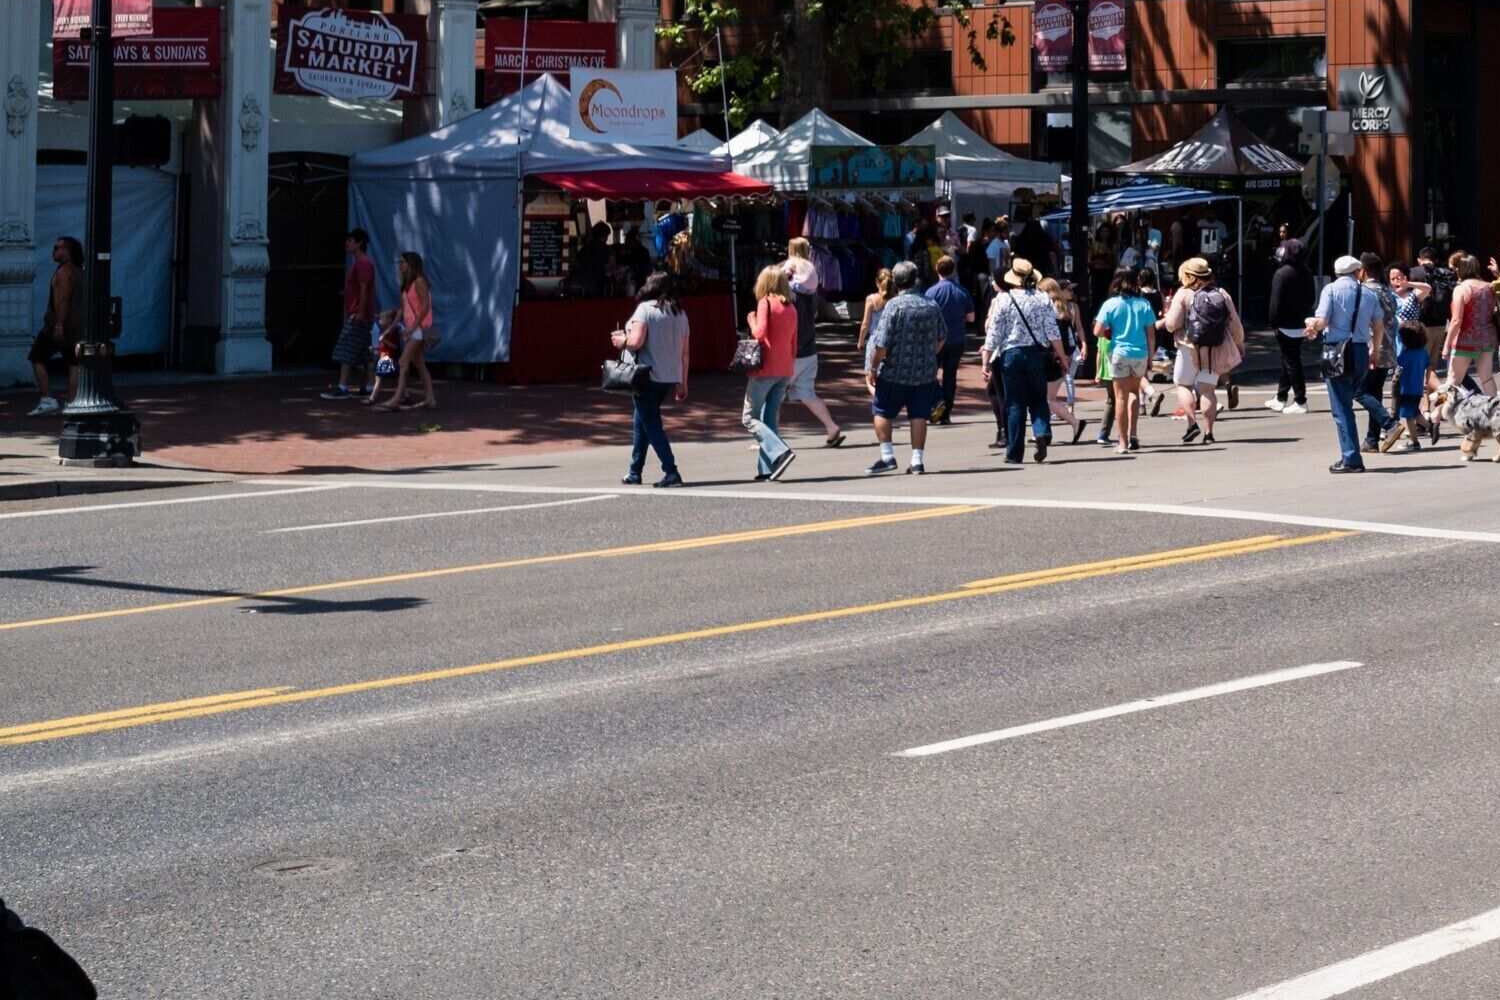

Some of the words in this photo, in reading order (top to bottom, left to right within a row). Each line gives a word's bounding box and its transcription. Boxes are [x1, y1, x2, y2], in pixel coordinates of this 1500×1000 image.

[1089, 11, 1123, 23] SATURDAY
[320, 21, 390, 41] PORTLAND
[68, 46, 138, 60] SATAYS
[142, 46, 151, 60] &
[155, 46, 206, 60] SUNDAYS
[296, 29, 409, 64] SATURDAY
[308, 50, 396, 79] MARKET
[495, 53, 528, 68] MARCH
[535, 55, 588, 68] CHRISTMAS
[590, 55, 606, 68] EVE
[591, 103, 666, 120] Moondrops
[1352, 107, 1391, 119] MERCY
[1352, 119, 1390, 131] CORPS
[1245, 180, 1257, 188] AVID
[1257, 180, 1273, 188] CIDER
